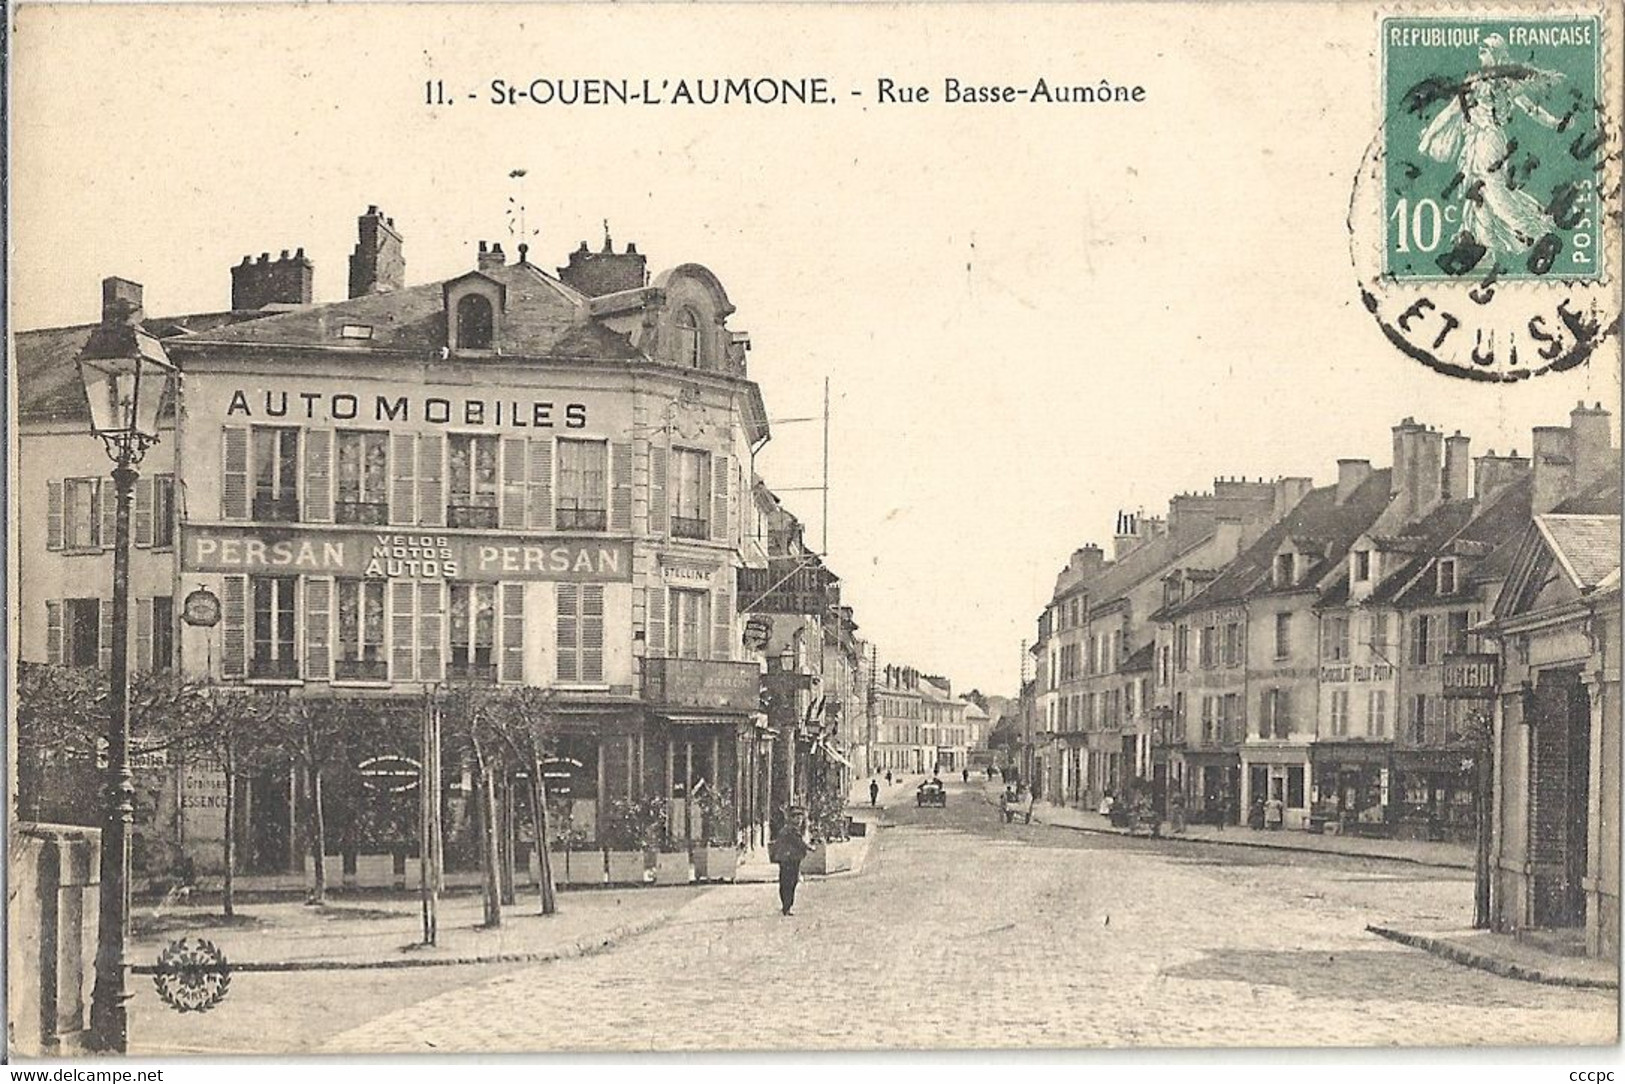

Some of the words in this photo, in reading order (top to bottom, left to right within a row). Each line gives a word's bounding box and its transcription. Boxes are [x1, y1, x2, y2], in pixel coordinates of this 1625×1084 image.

[1391, 27, 1481, 47] REPUBLIQUE
[1509, 26, 1592, 48] FRANÇAISE
[1572, 178, 1593, 264] POSTES
[226, 389, 588, 429] AUTOMOBILES
[196, 538, 345, 567] PERSAN
[372, 546, 453, 560] MOTOS
[376, 534, 449, 547] VELOS
[364, 559, 460, 579] AUTOS
[479, 545, 619, 574] PERSAN
